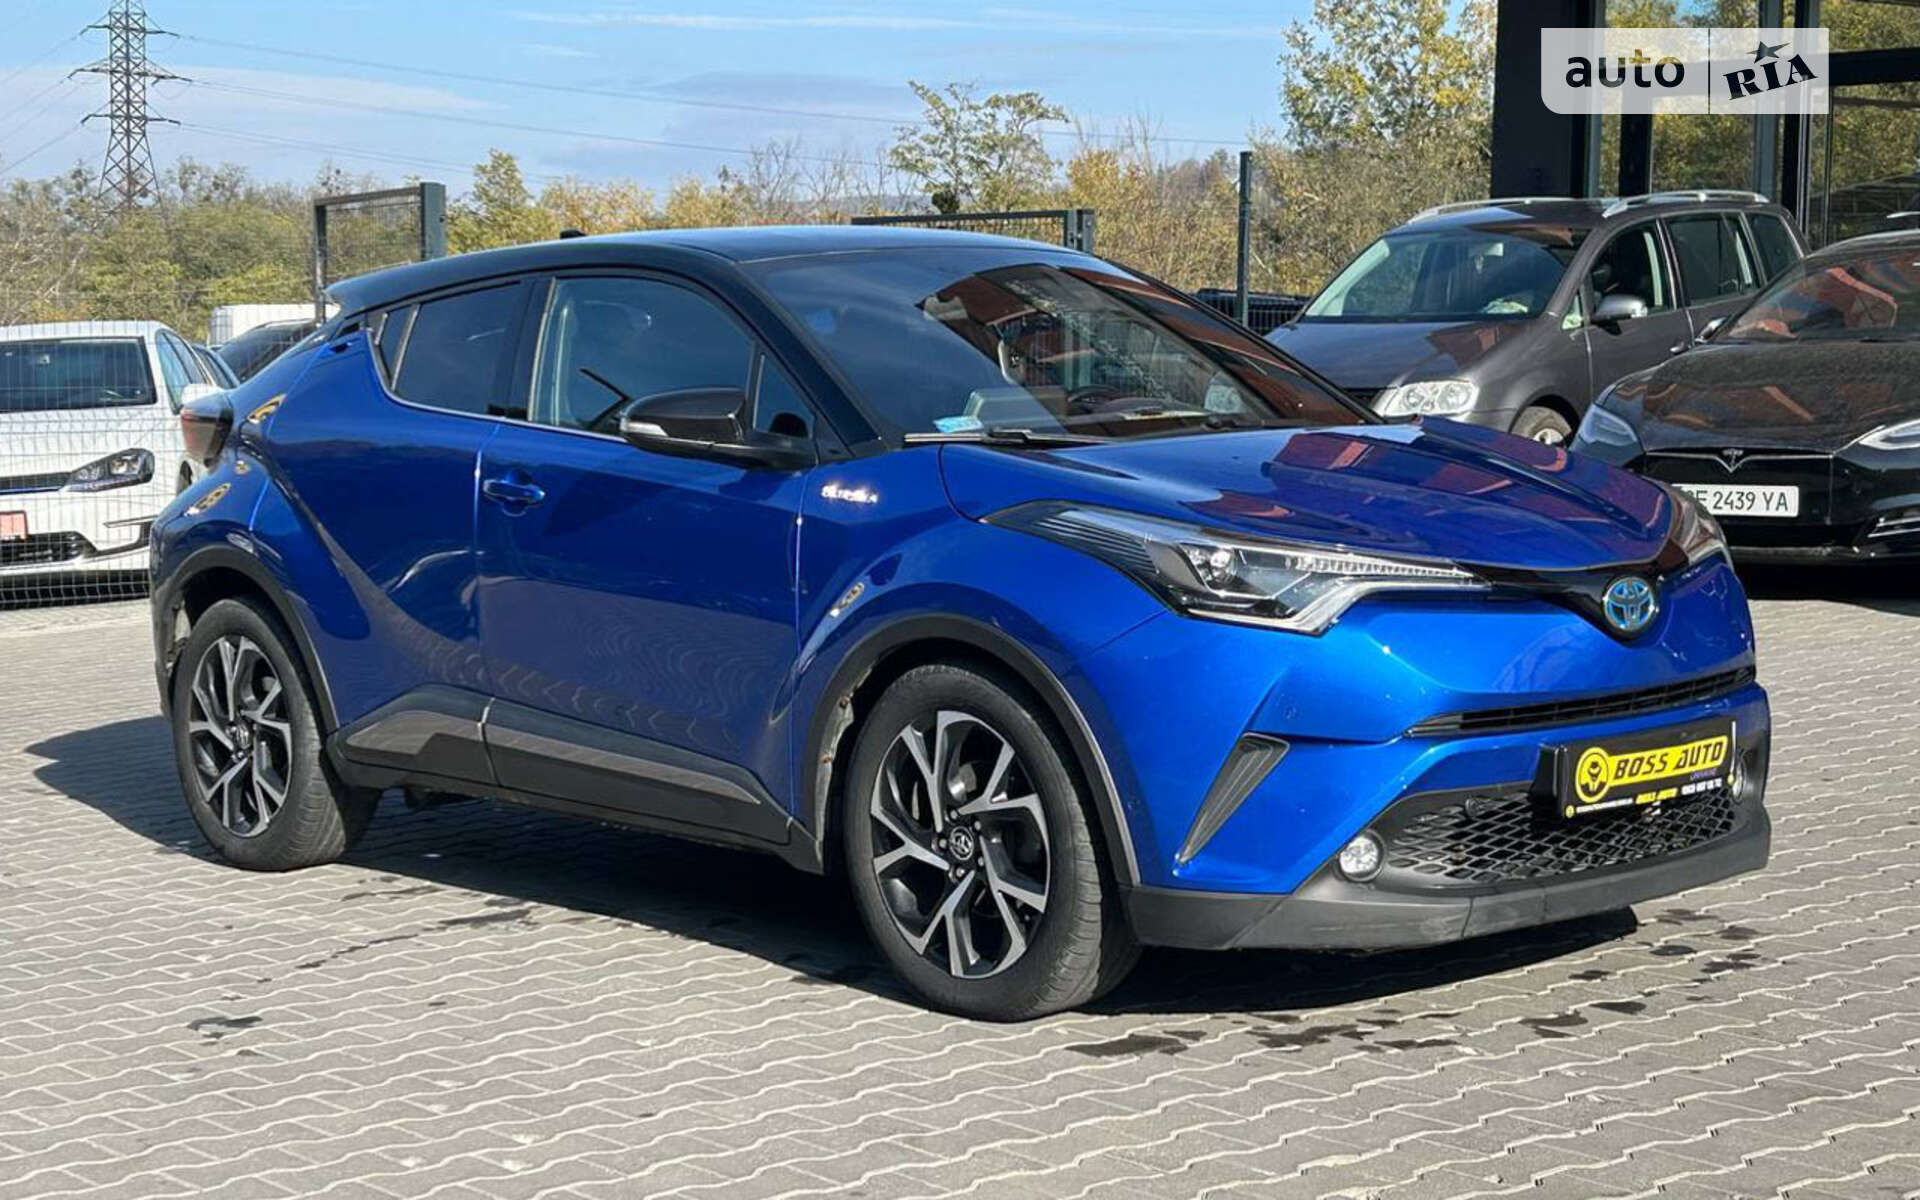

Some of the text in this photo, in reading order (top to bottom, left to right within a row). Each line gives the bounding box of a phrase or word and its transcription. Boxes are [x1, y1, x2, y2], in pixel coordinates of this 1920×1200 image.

[1713, 491, 1755, 511] 2439
[1762, 492, 1788, 512] YA
[1614, 753, 1669, 780] BOSS
[1673, 741, 1724, 770] AUTO
